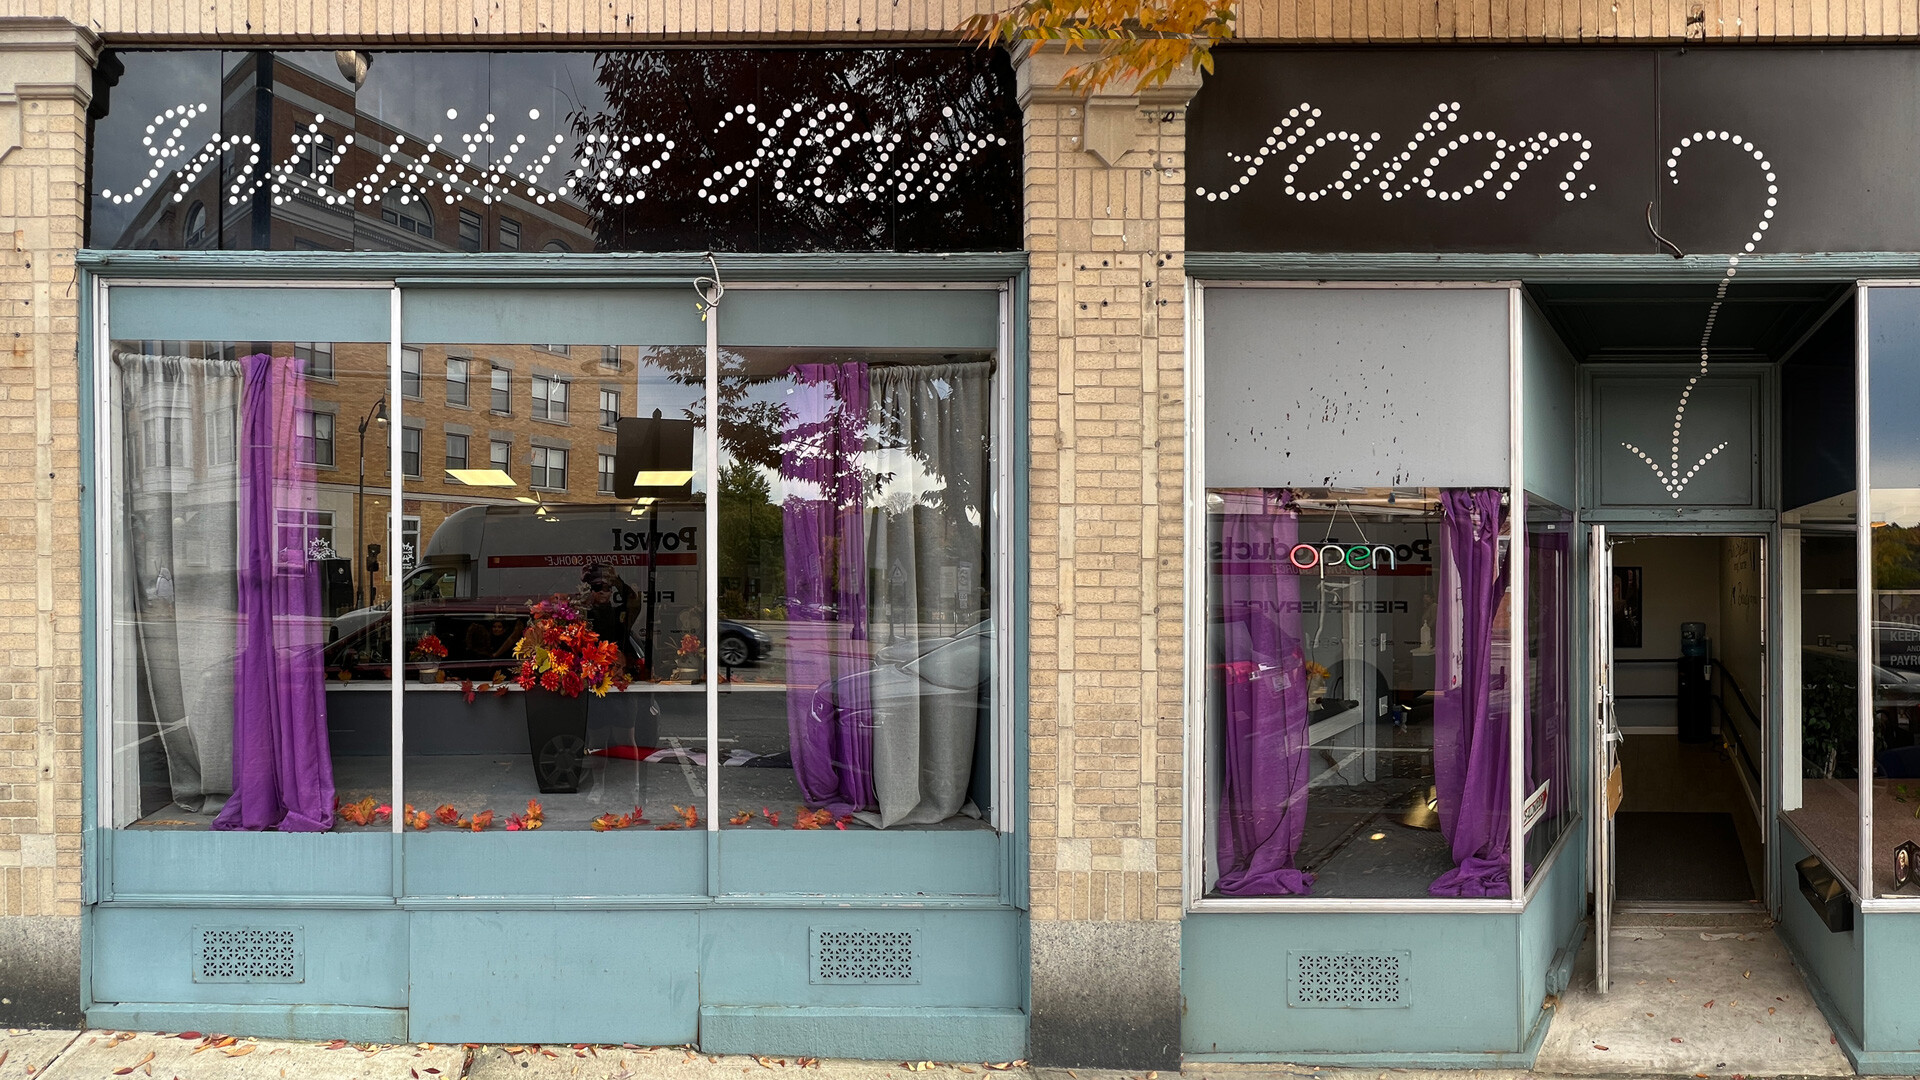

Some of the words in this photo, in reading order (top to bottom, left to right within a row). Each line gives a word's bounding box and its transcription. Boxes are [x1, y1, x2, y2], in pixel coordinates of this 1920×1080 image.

[102, 103, 675, 204] Intuitive
[697, 102, 1006, 204] Hair
[1195, 101, 1596, 201] Salon
[1290, 544, 1396, 579] open
